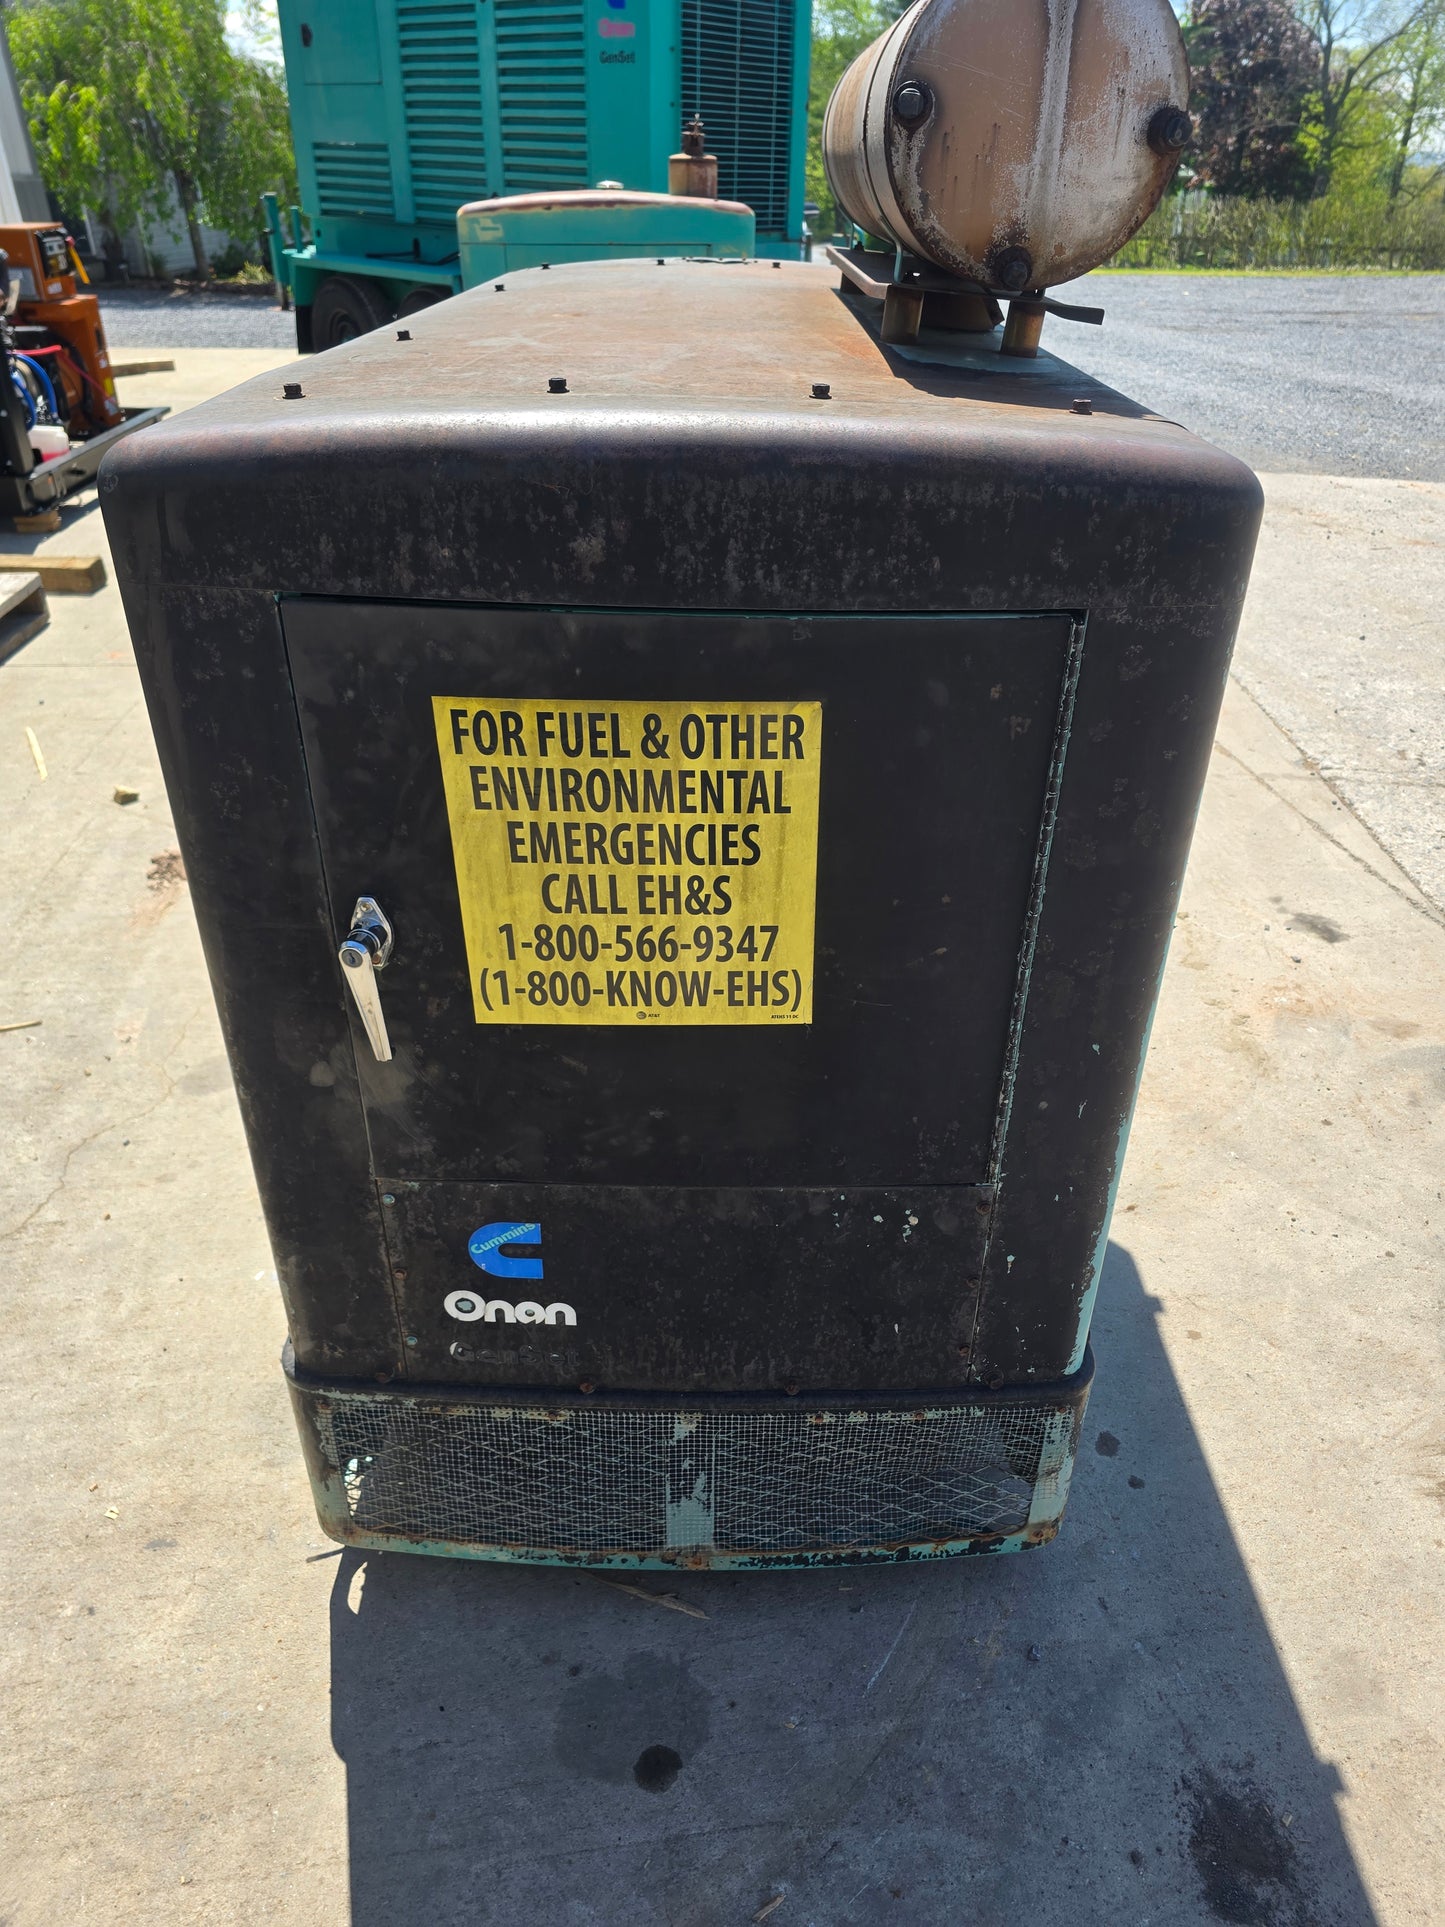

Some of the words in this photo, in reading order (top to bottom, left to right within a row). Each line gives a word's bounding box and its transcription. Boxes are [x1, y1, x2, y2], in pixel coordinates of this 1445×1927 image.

[449, 708, 528, 757] FOR
[536, 711, 631, 759] FUEL
[640, 713, 670, 760] &
[680, 713, 805, 760] OTHER
[469, 765, 792, 814] ENVIRONMENTAL
[506, 821, 761, 866] EMERGENCIES
[541, 873, 628, 915] CALL
[637, 874, 732, 916] EH&S
[498, 923, 779, 962] 1-800-566-9347
[480, 968, 802, 1012] (1-800-KNOW-EHS)
[470, 1222, 537, 1254] Cummins
[443, 1289, 578, 1326] Onan
